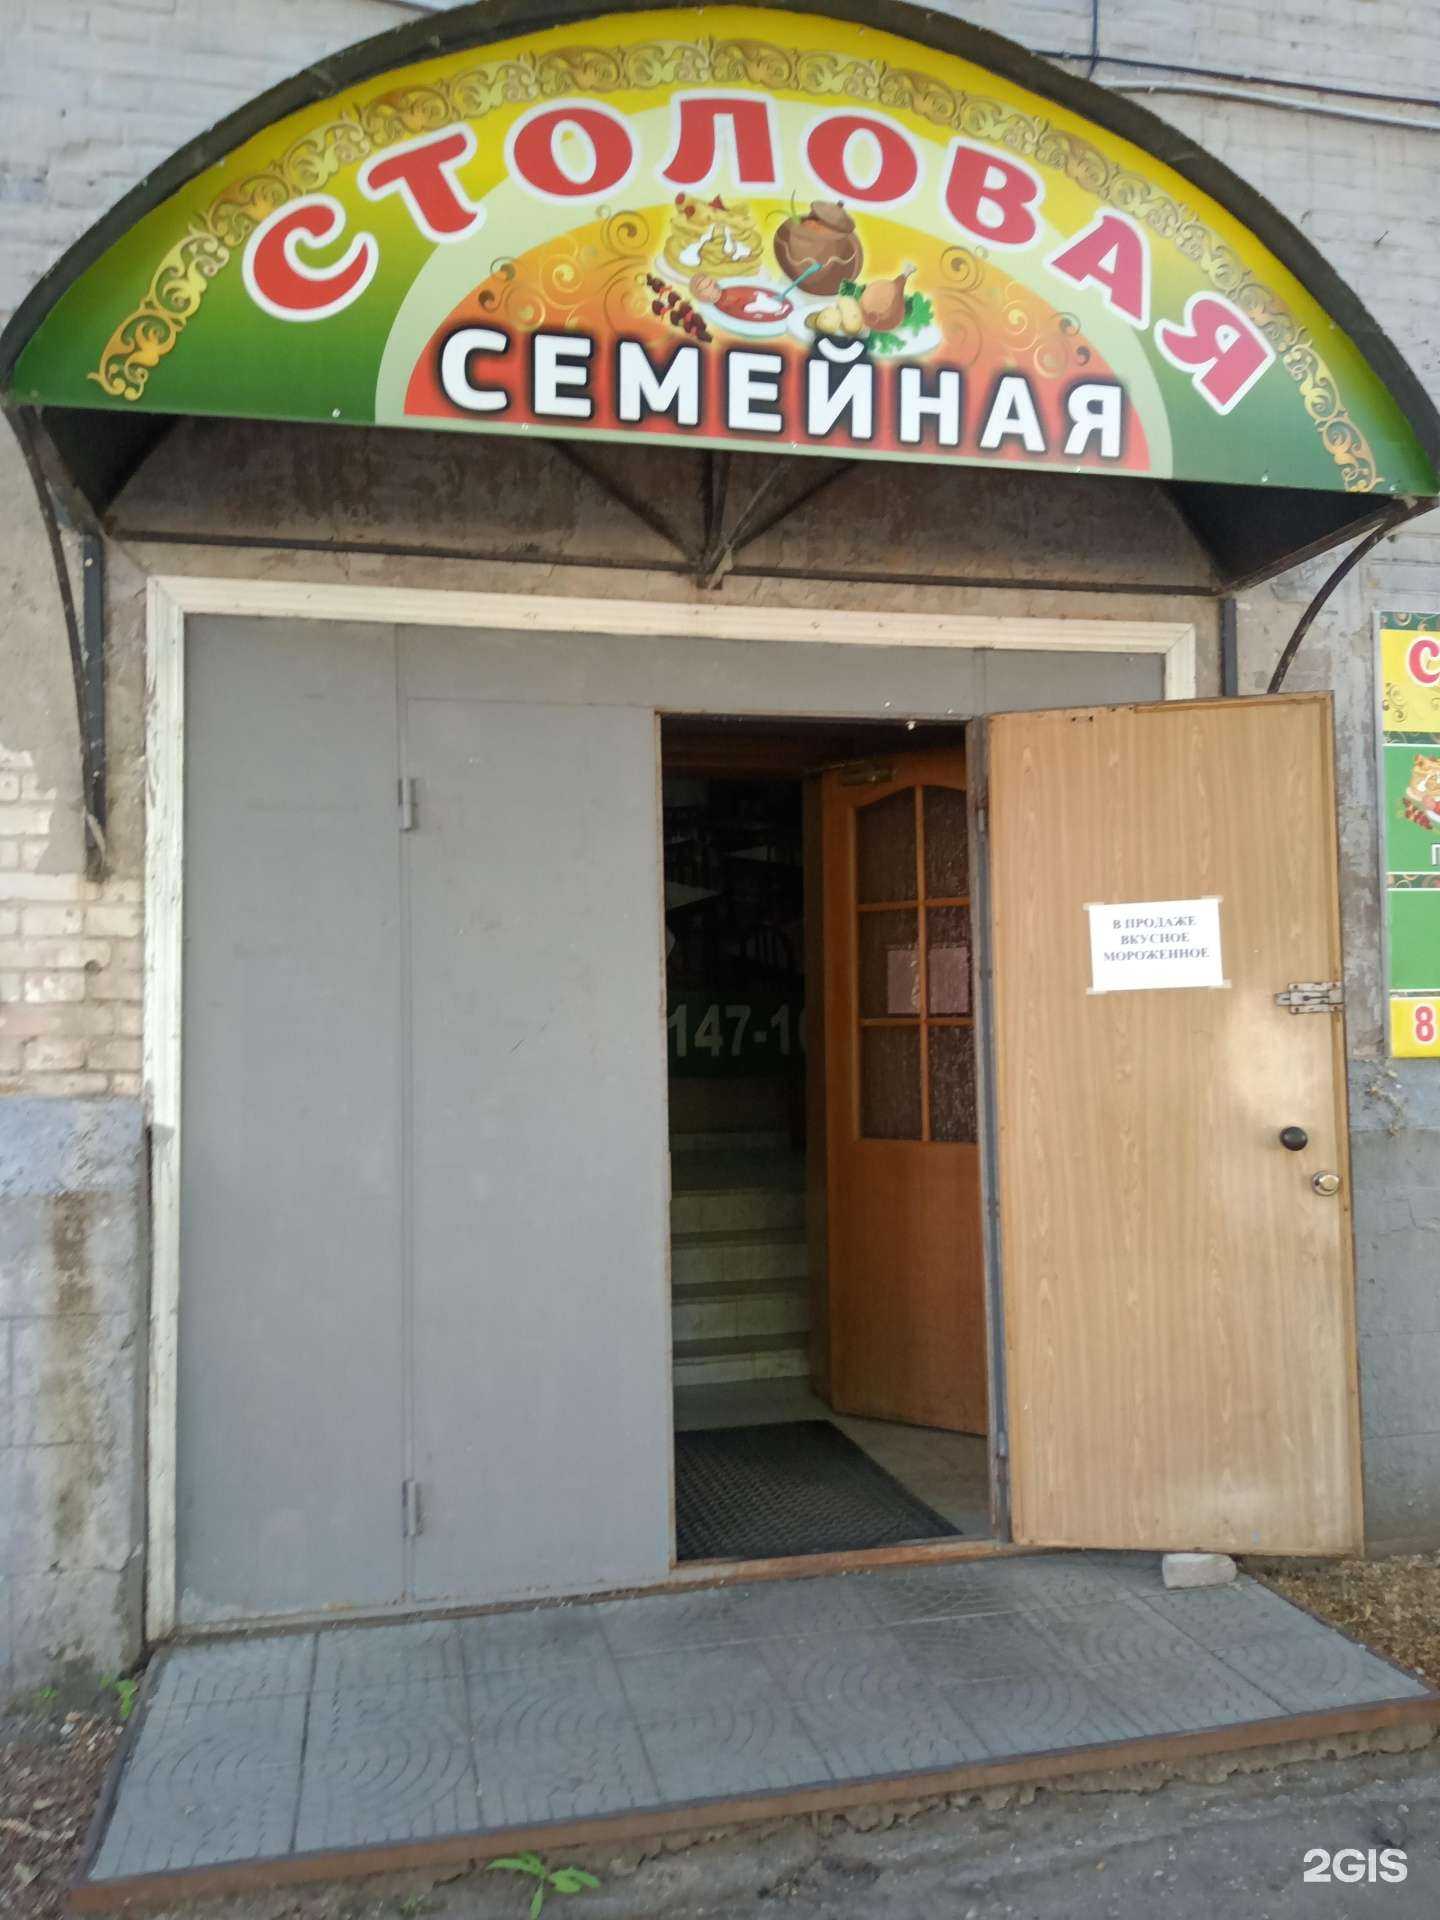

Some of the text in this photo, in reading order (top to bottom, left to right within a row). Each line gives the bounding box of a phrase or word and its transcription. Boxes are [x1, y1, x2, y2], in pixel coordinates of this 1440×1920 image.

[246, 93, 1273, 409] СТОЛОВАЯ
[439, 327, 1124, 459] СЕМЕЙНАЯ
[1112, 915, 1196, 930] В ПРОДАЖЕ
[1120, 932, 1191, 945] ВКУСНОЕ
[1103, 948, 1211, 962] МОРОЖЕННОЕ
